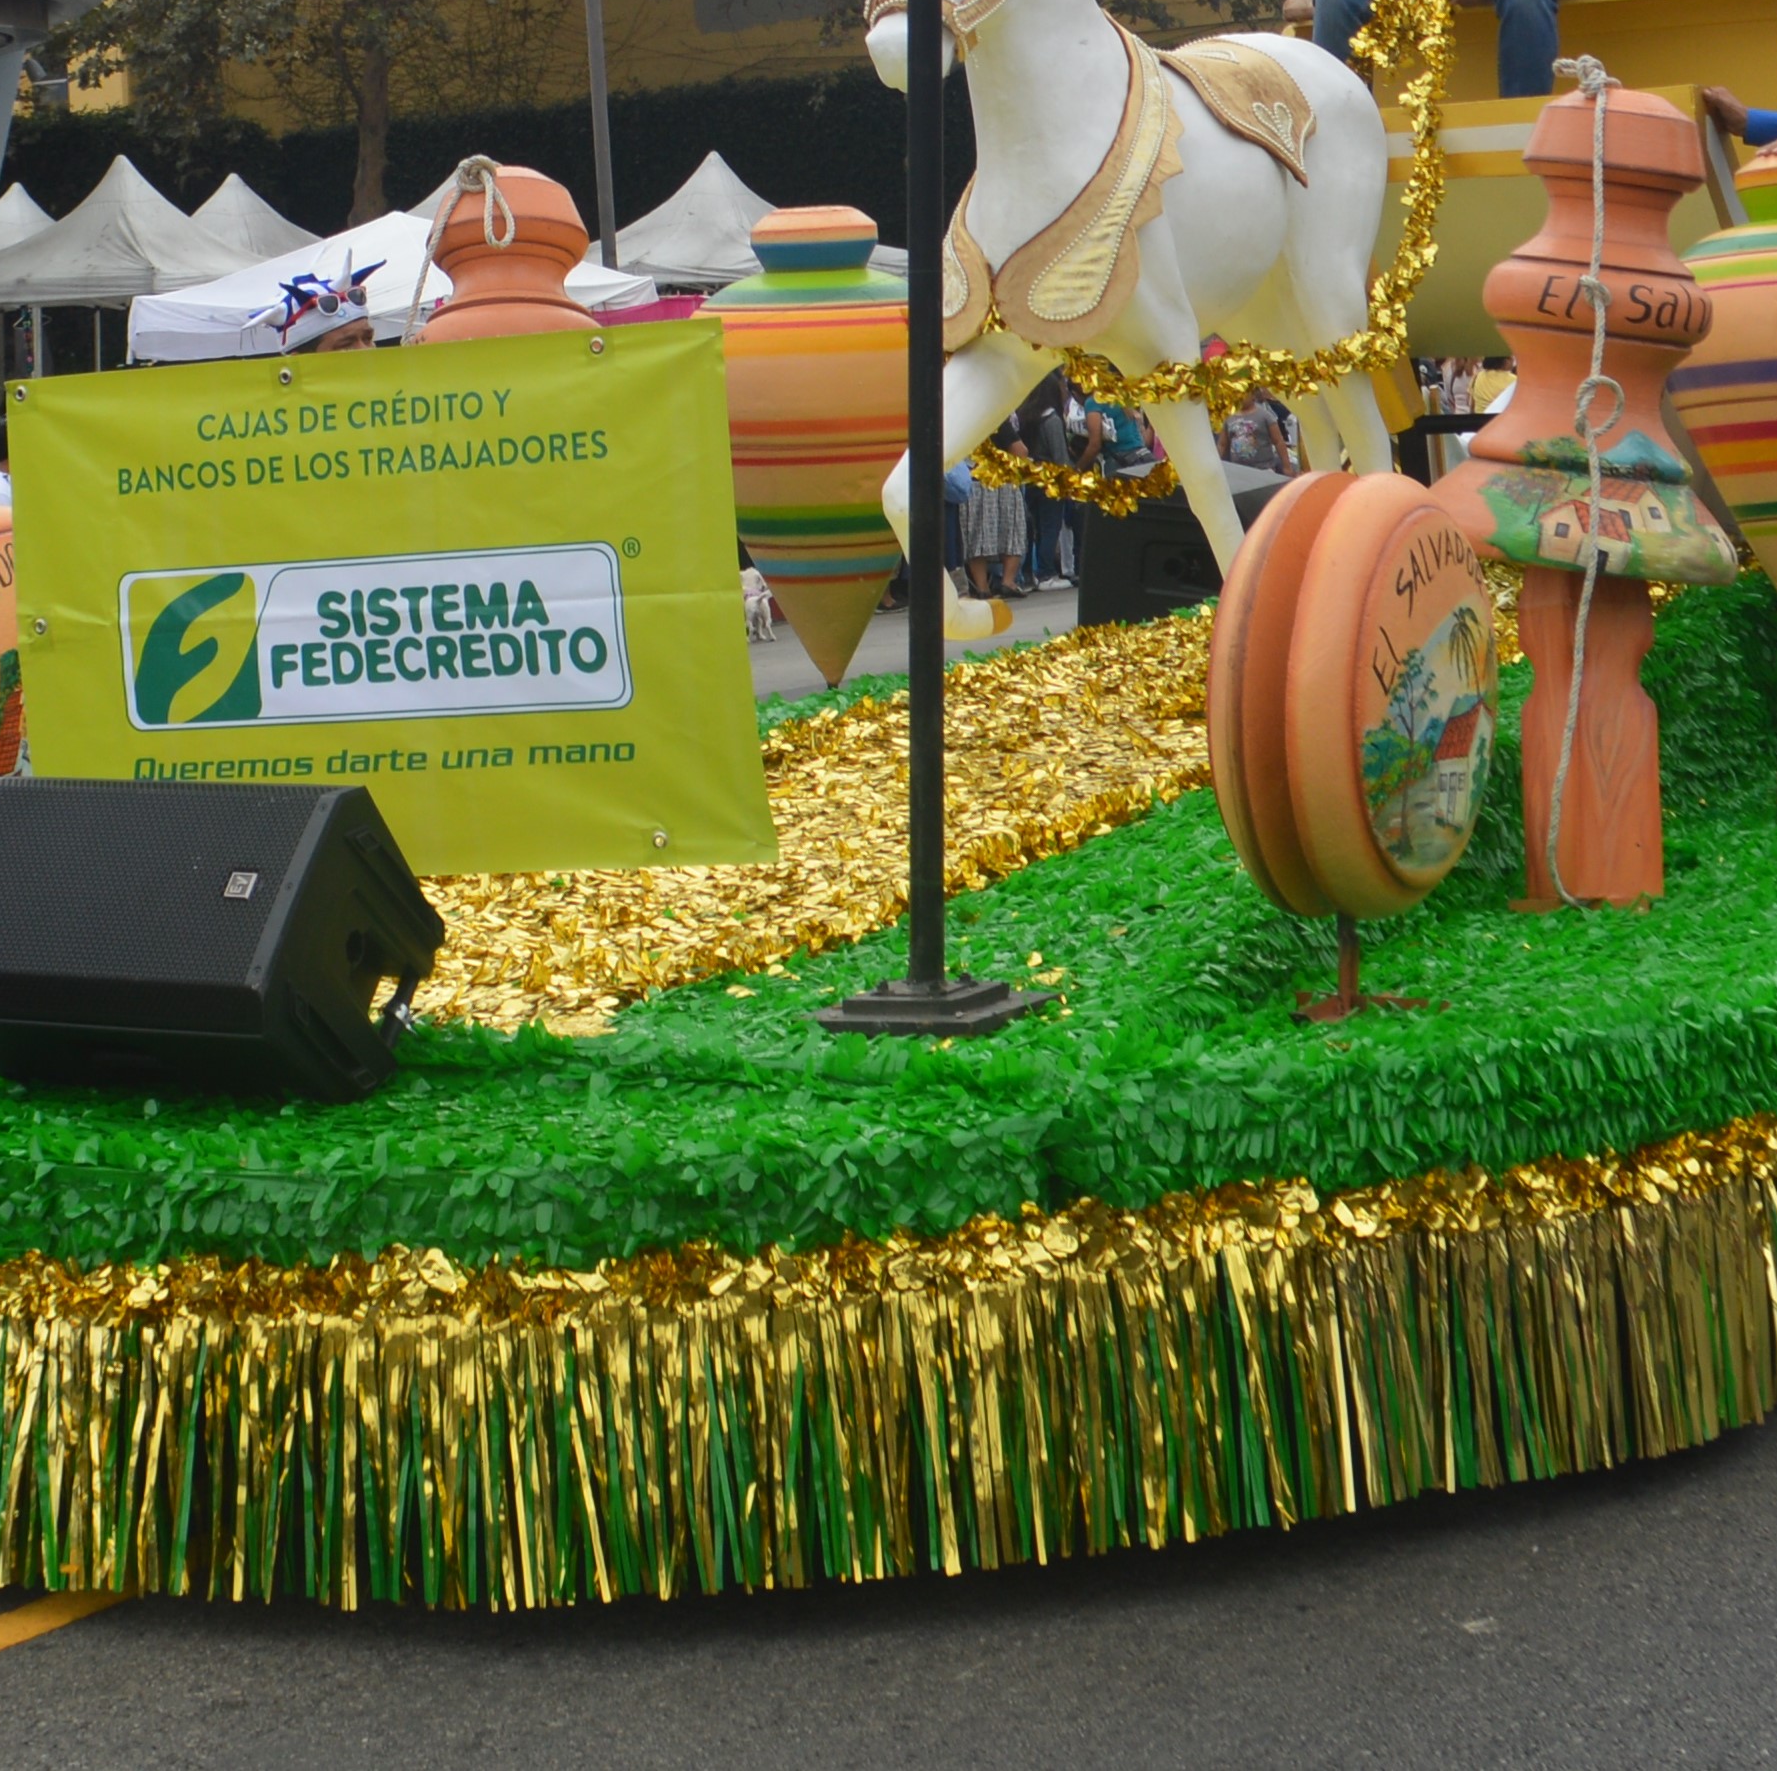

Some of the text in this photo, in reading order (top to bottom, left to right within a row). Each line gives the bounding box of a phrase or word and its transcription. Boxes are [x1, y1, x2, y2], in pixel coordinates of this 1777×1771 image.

[1537, 274, 1584, 320] El
[196, 388, 512, 443] CAJAS DE CRÉDITO Y
[117, 429, 610, 496] BANCOS DE LOS TRABAJADORES
[316, 579, 550, 639] SISTEMA
[270, 626, 608, 689] FEDECREDITO
[134, 741, 636, 781] Queremos darte una mano
